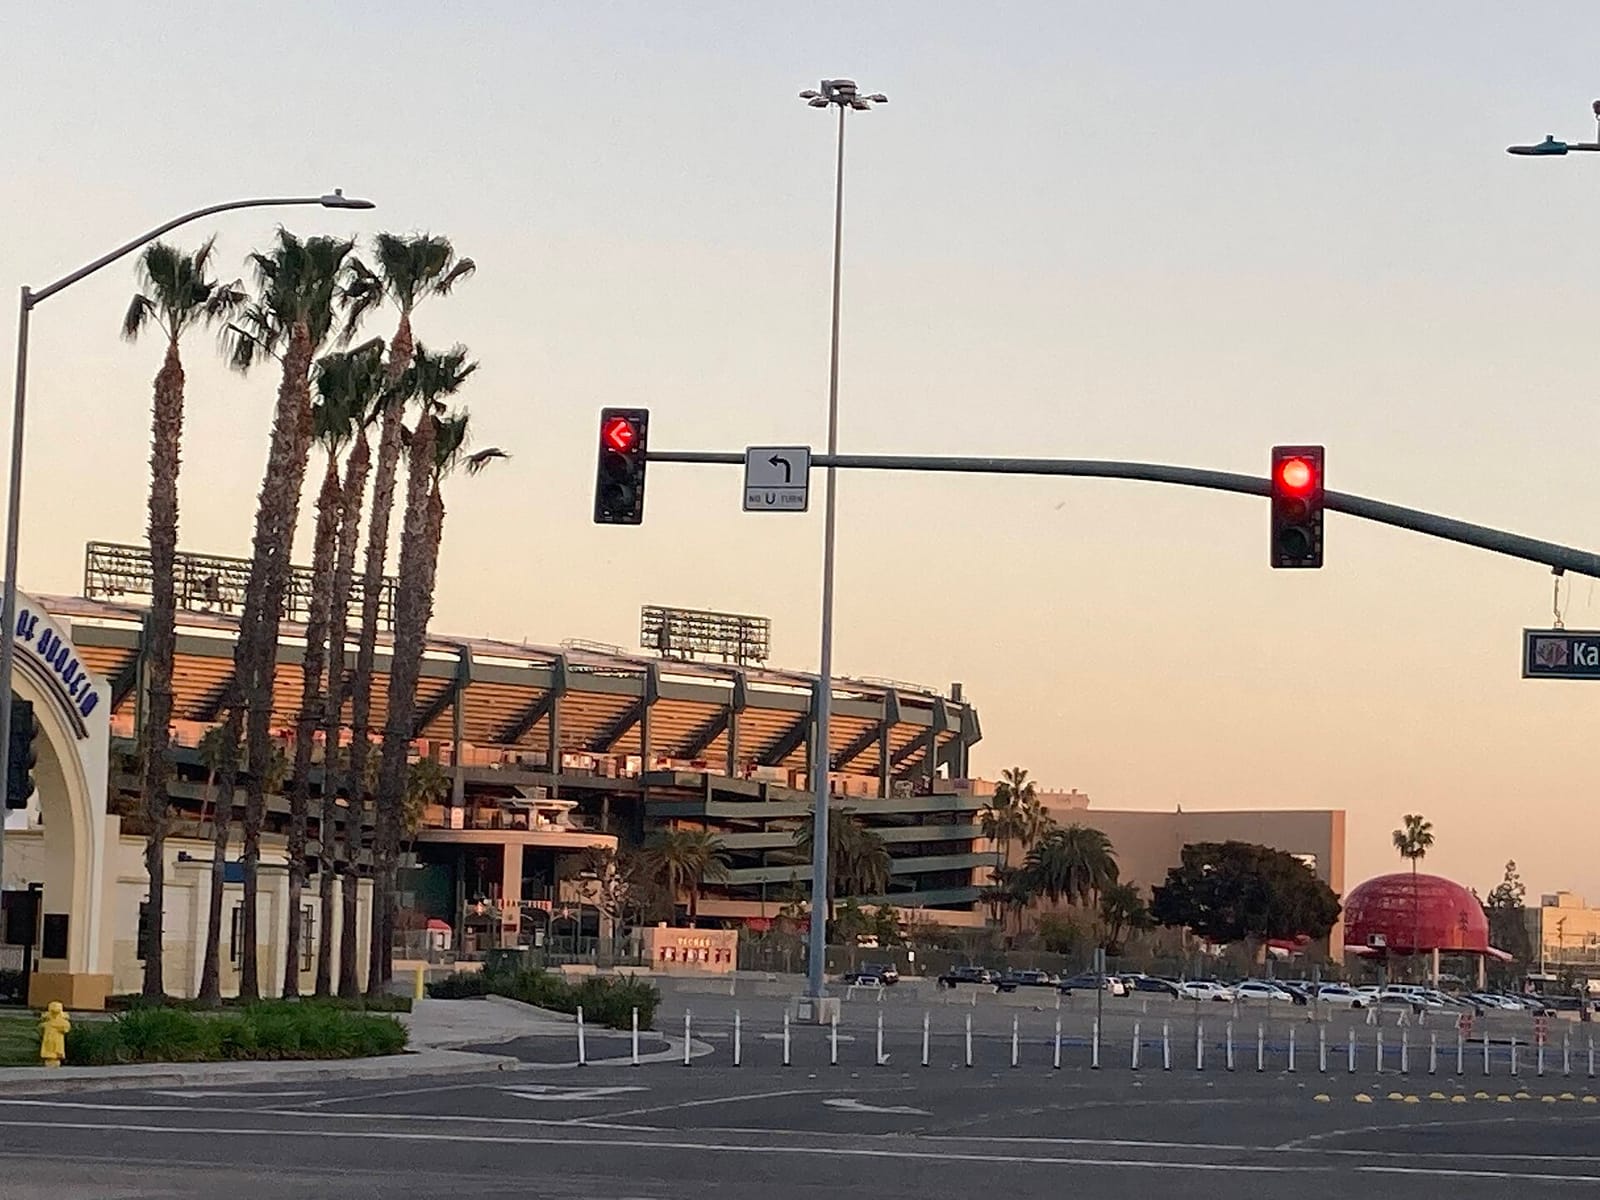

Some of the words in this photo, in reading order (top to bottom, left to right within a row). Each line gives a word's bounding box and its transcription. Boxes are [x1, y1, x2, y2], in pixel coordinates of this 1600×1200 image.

[765, 492, 776, 505] U
[781, 495, 803, 504] TURN
[1573, 642, 1599, 666] Ka
